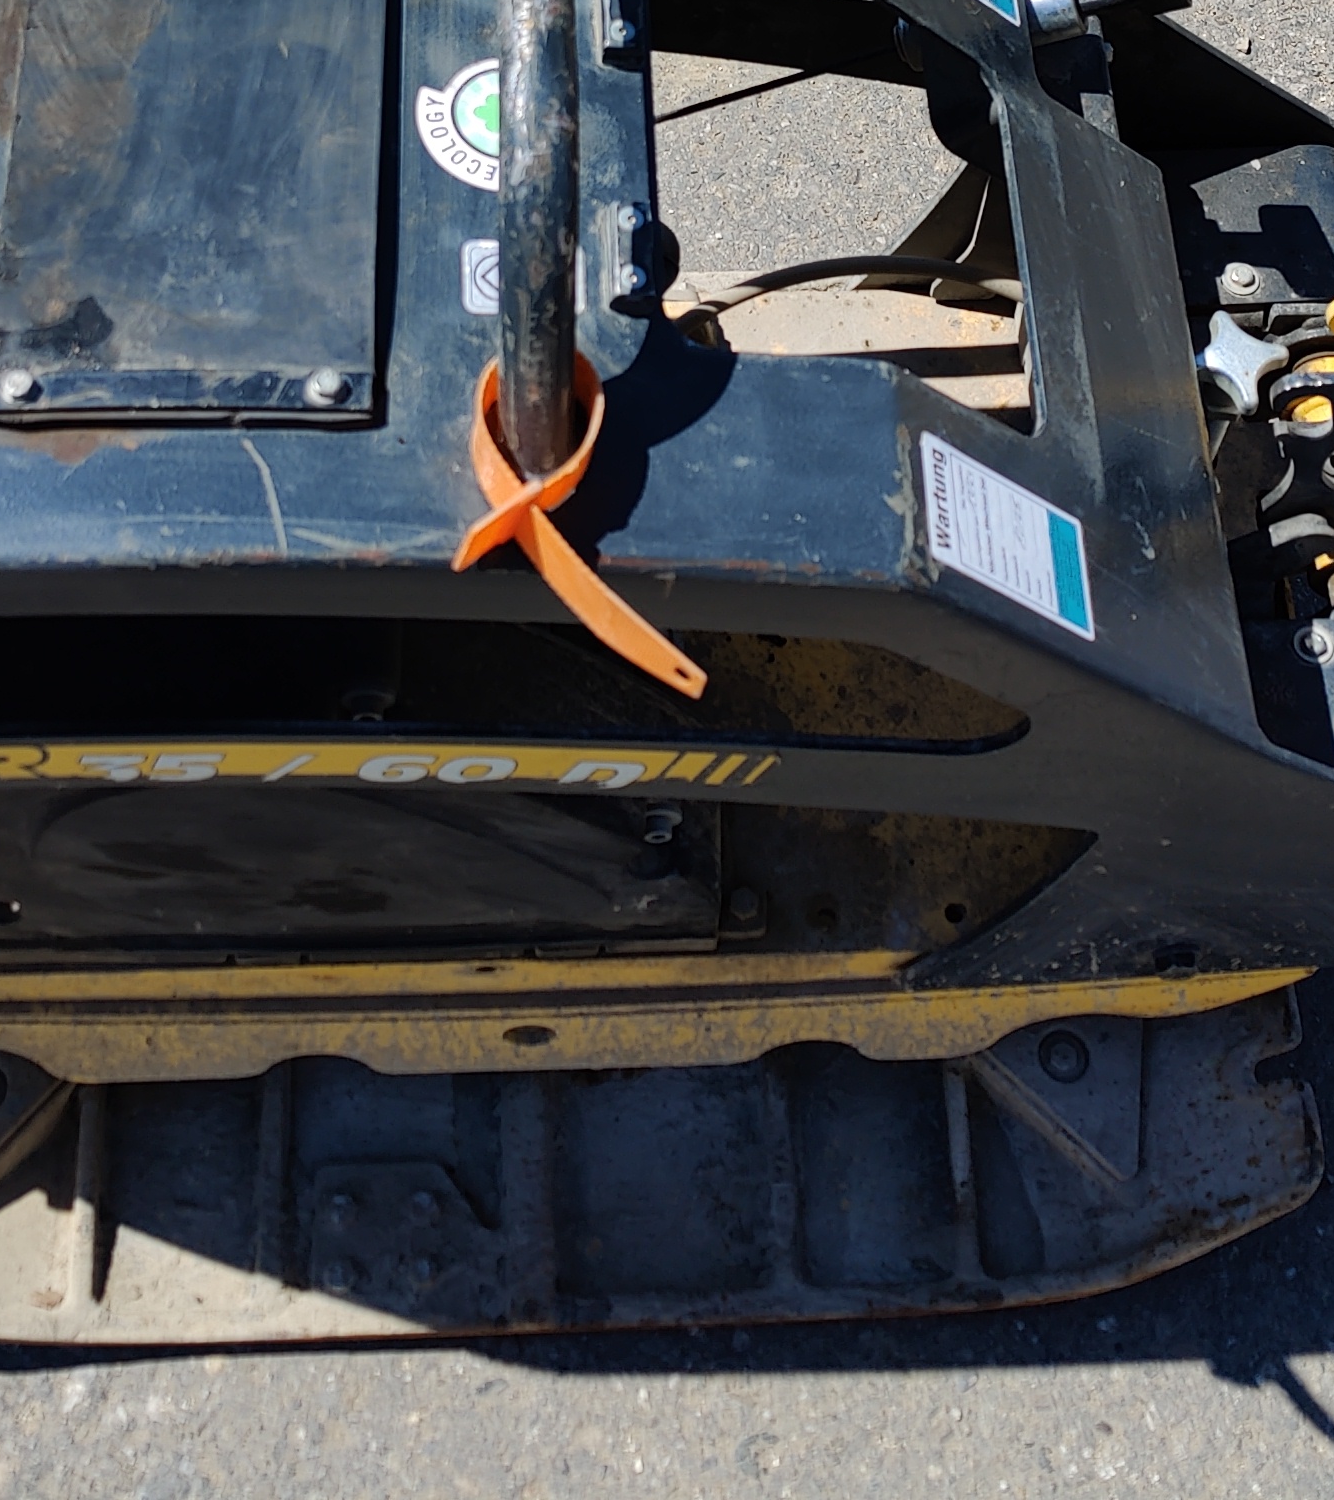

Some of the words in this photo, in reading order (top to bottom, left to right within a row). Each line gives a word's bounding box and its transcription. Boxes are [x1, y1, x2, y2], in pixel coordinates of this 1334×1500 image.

[425, 96, 498, 181] ECOLOGY
[931, 448, 953, 550] Wartung
[78, 753, 226, 783] 35
[357, 754, 519, 784] 60
[558, 760, 648, 790] D
